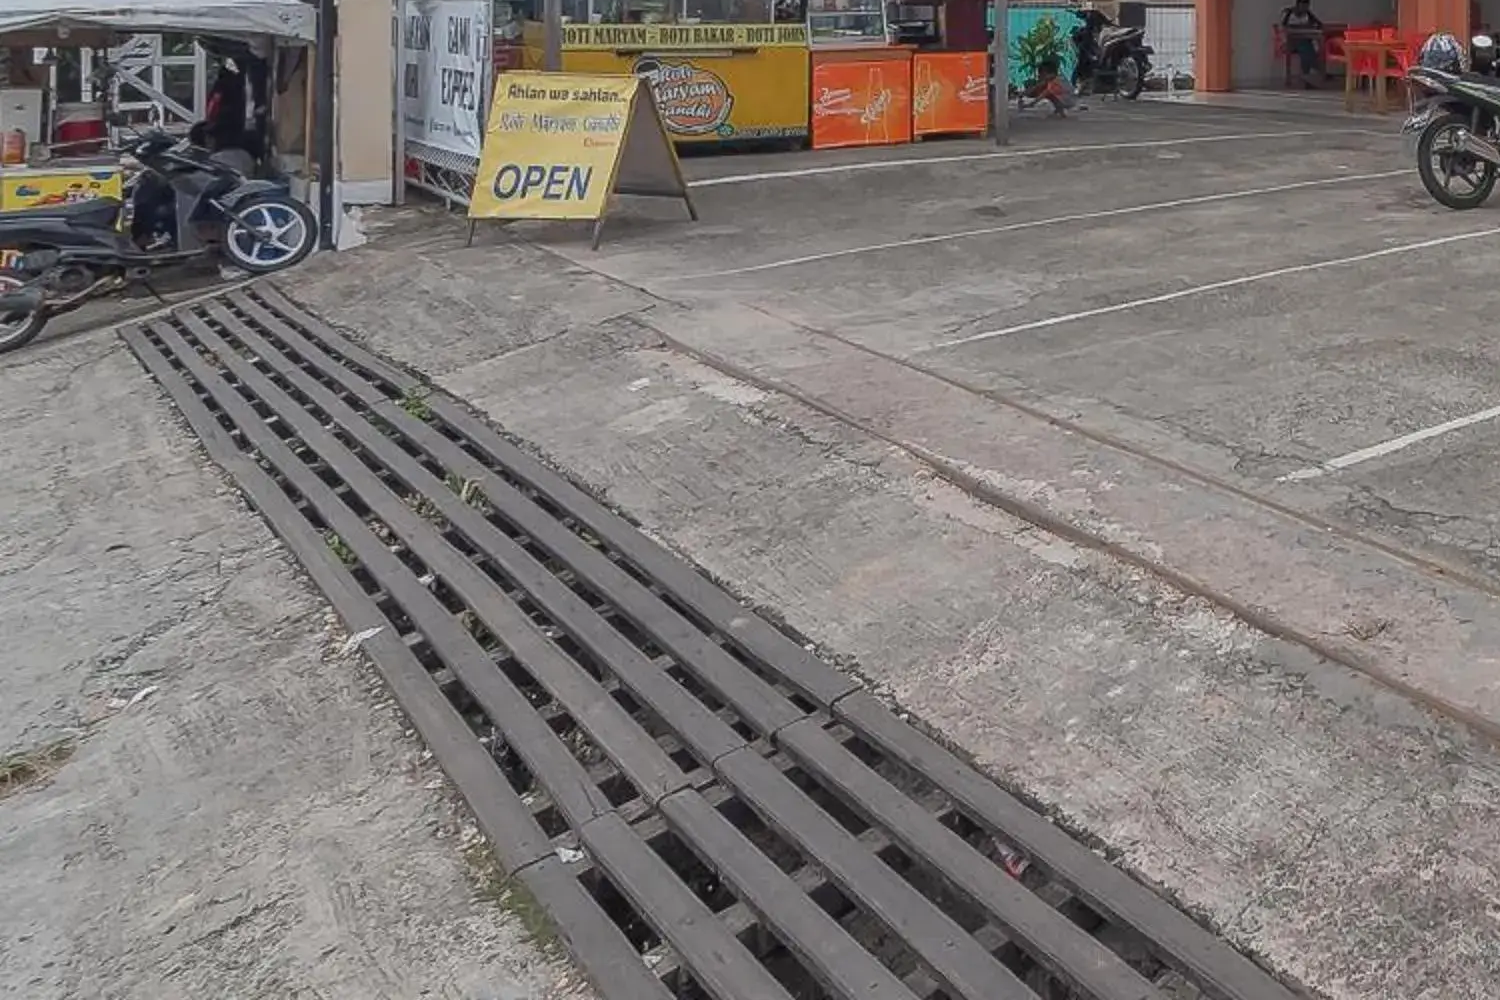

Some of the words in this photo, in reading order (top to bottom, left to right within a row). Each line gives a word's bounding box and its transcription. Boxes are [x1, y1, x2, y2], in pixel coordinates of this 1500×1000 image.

[660, 27, 689, 44] ROTI
[507, 83, 546, 100] Ahlan
[549, 88, 569, 100] wa
[493, 163, 593, 201] OPEN
